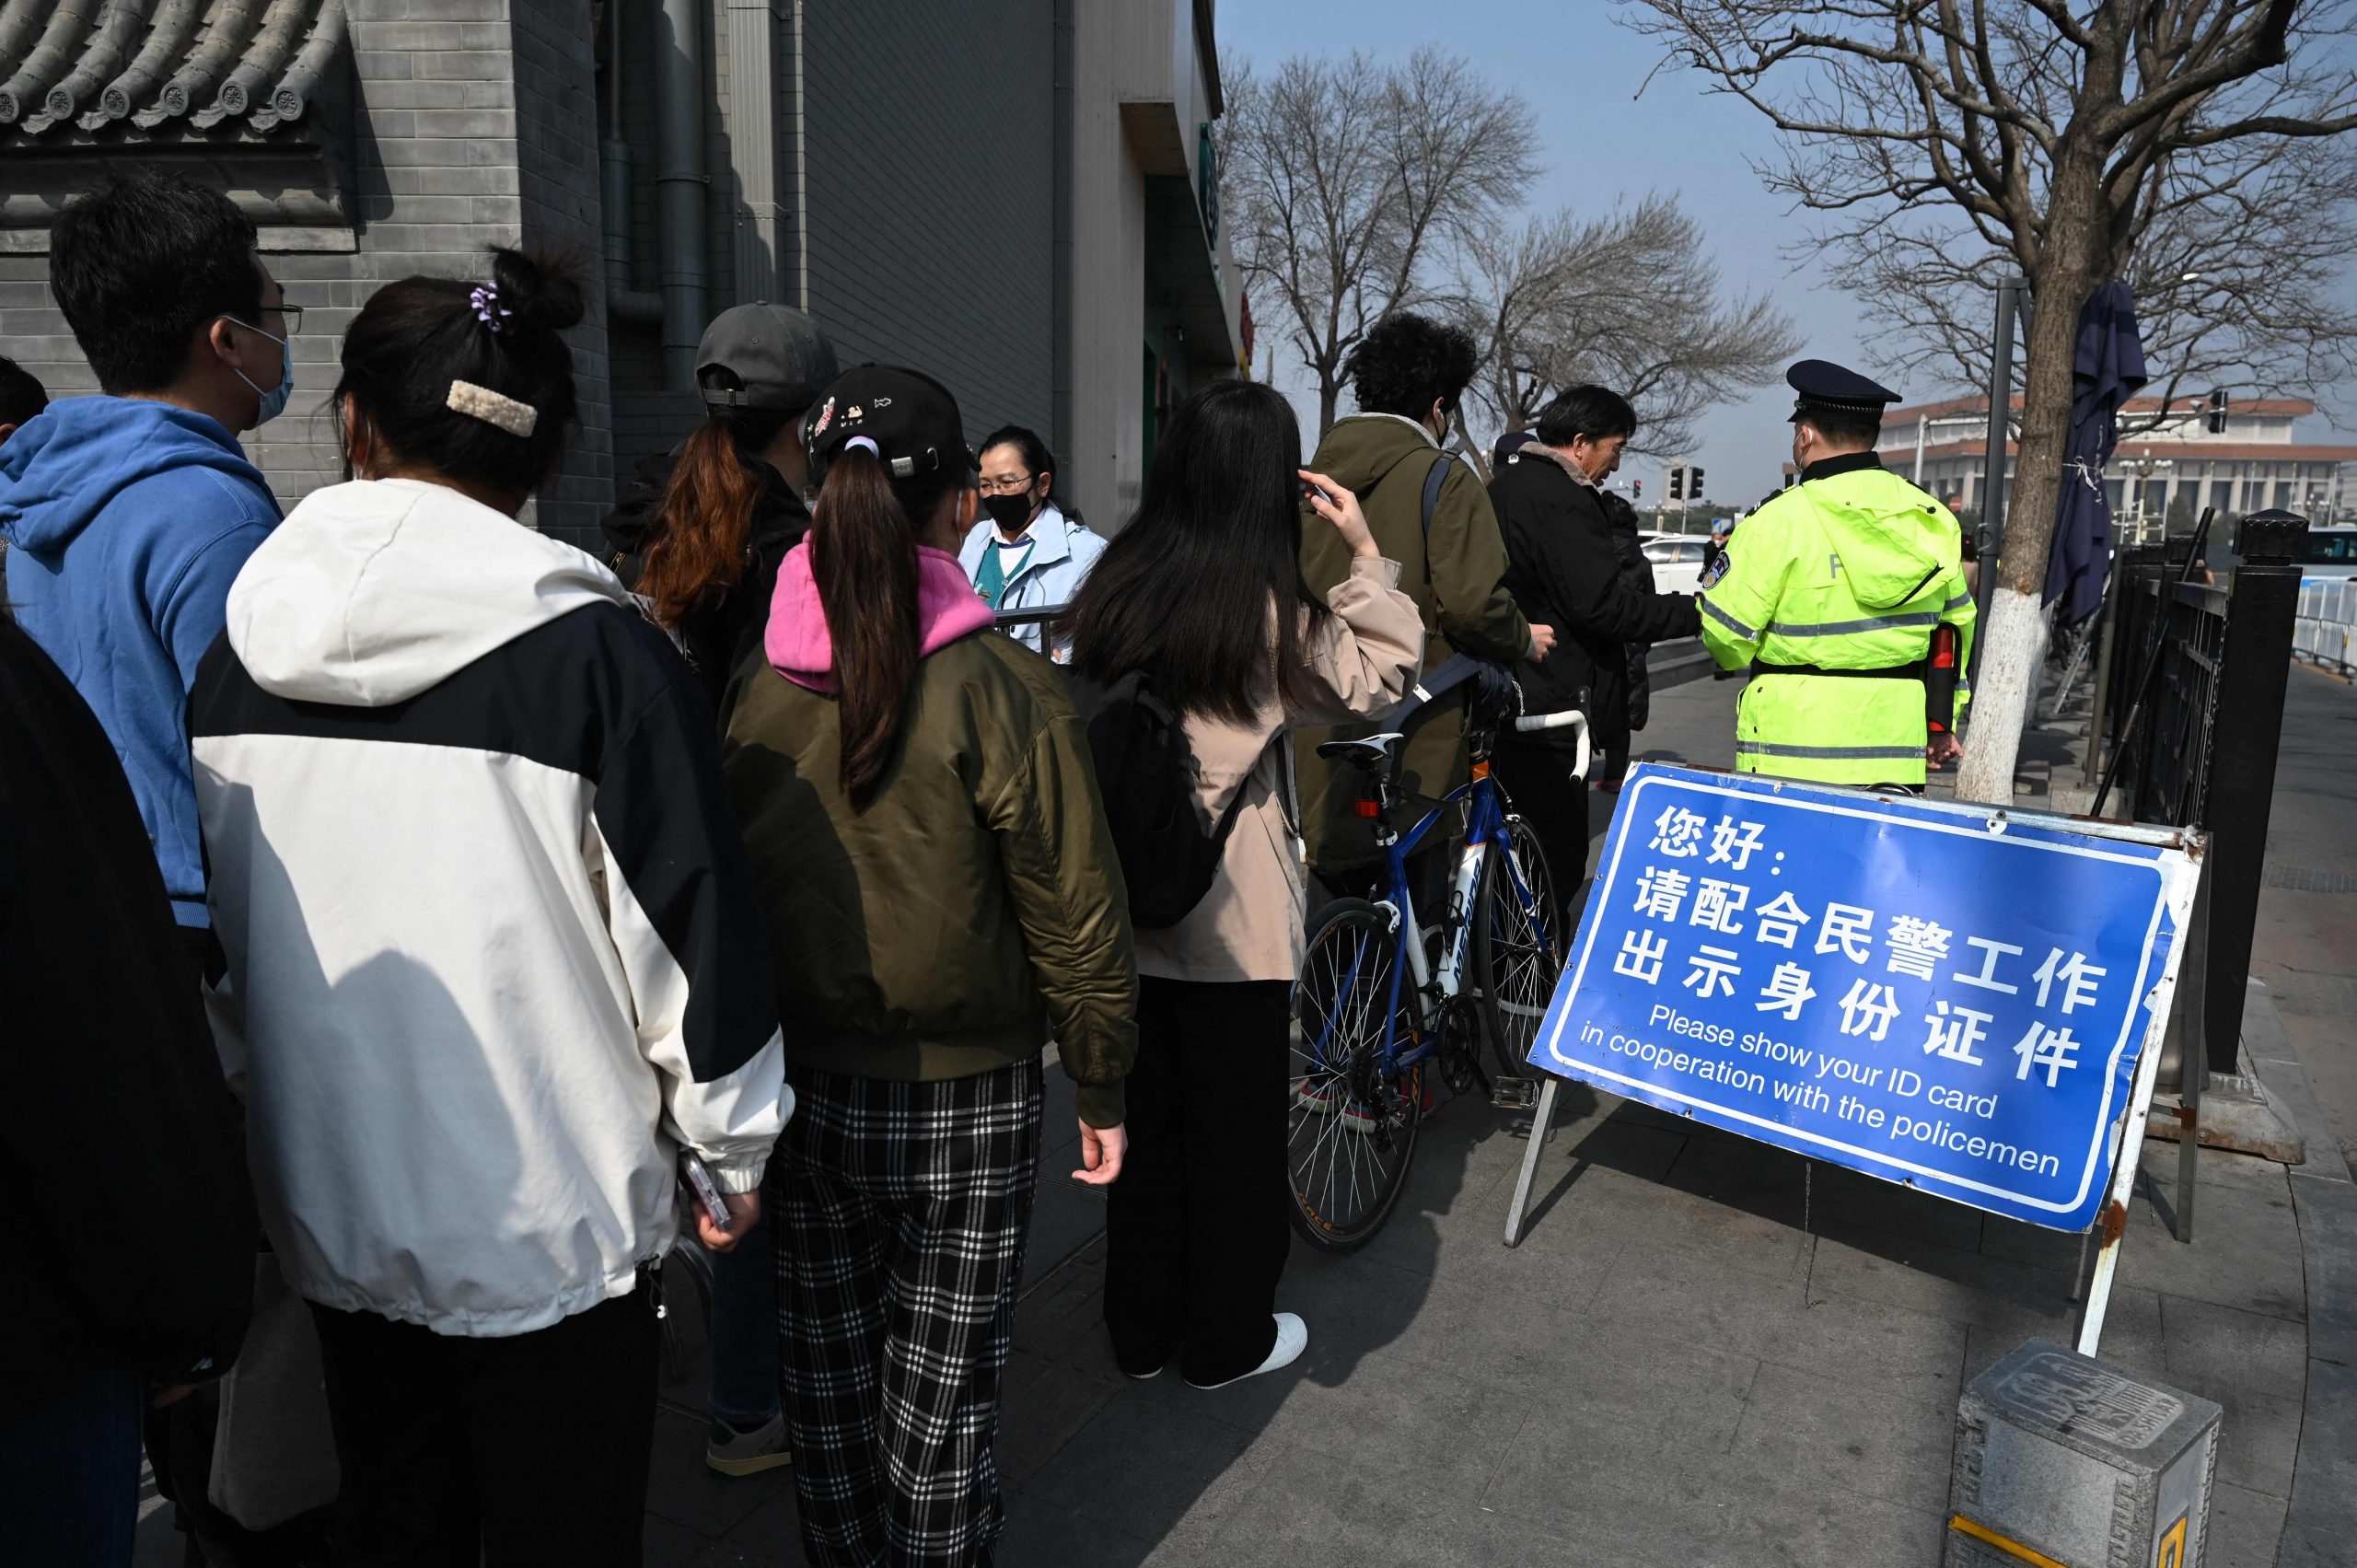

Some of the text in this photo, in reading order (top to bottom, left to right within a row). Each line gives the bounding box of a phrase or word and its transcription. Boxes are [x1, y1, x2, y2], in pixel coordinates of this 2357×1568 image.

[1611, 927, 2082, 1089] 出示身份证件
[1631, 865, 2108, 1016] 请配合民警工作
[1579, 1019, 2061, 1179] in cooperation with the policemen
[1648, 1003, 1999, 1120] Please show your ID card
